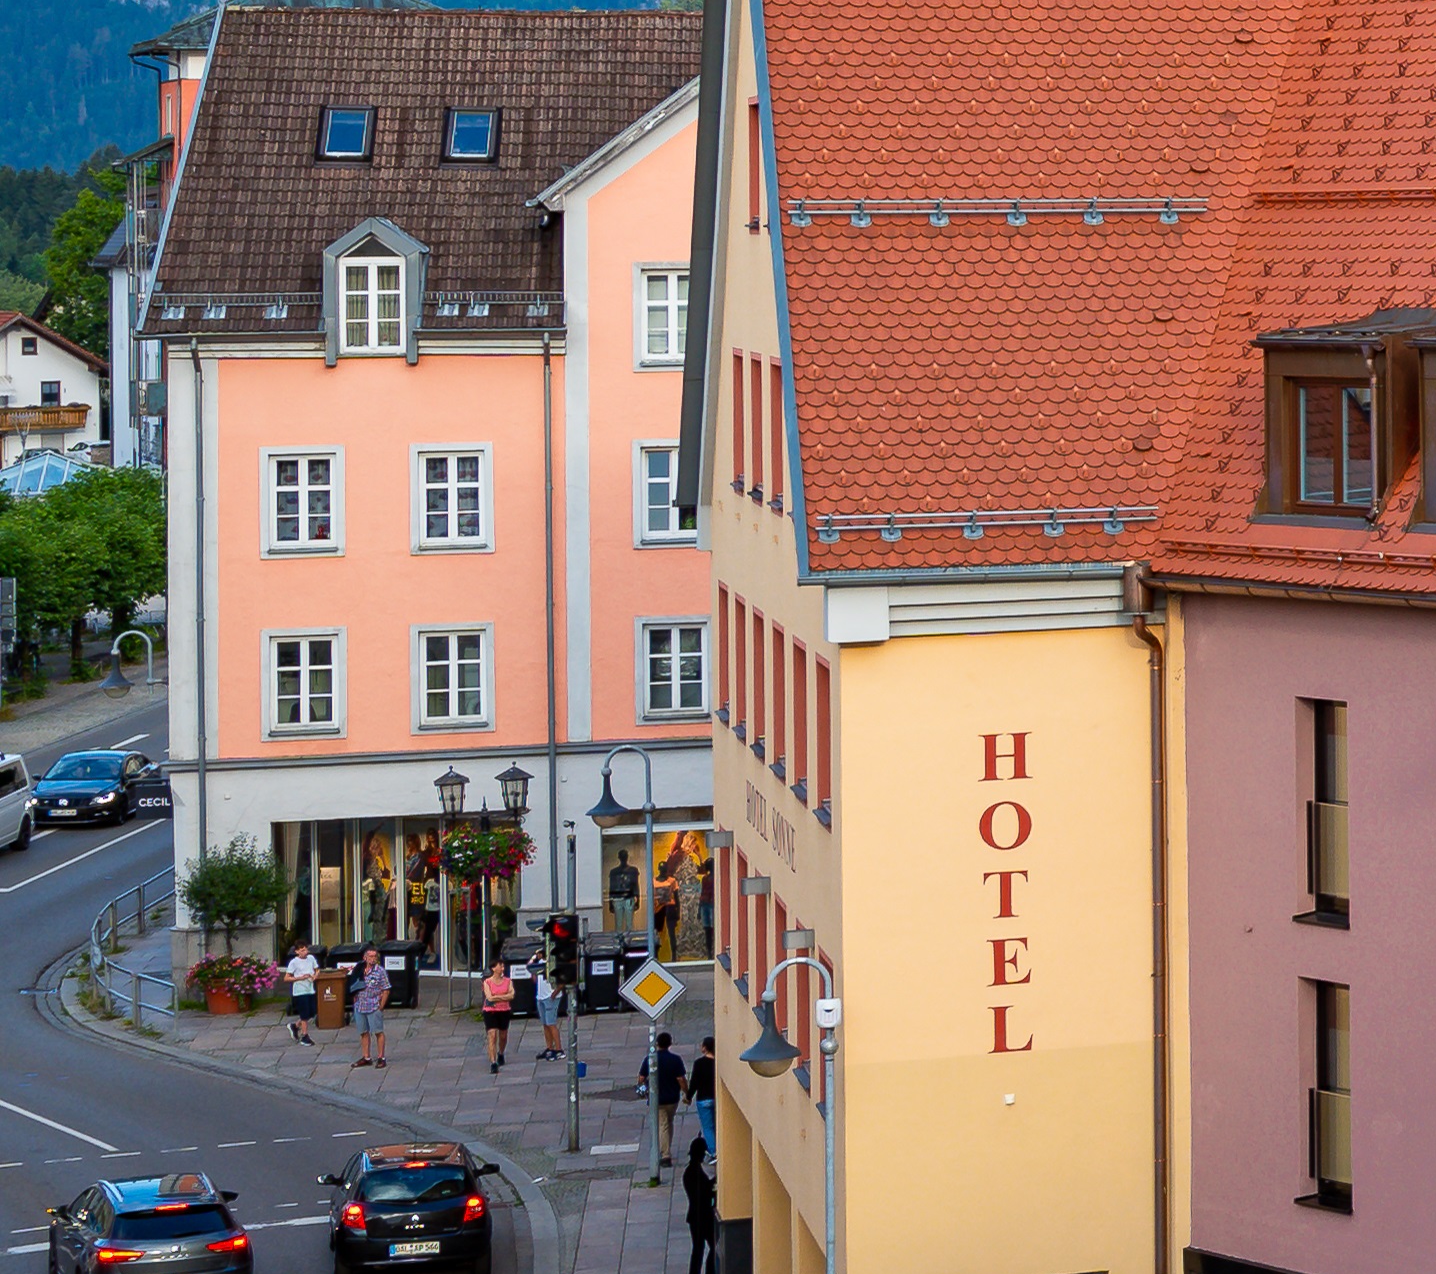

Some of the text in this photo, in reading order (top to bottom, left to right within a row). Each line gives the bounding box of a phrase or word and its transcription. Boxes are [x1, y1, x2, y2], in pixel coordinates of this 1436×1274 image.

[138, 797, 171, 807] CECIL
[746, 779, 796, 873] HOTEL SONNE
[978, 731, 1033, 1054] HOTEL
